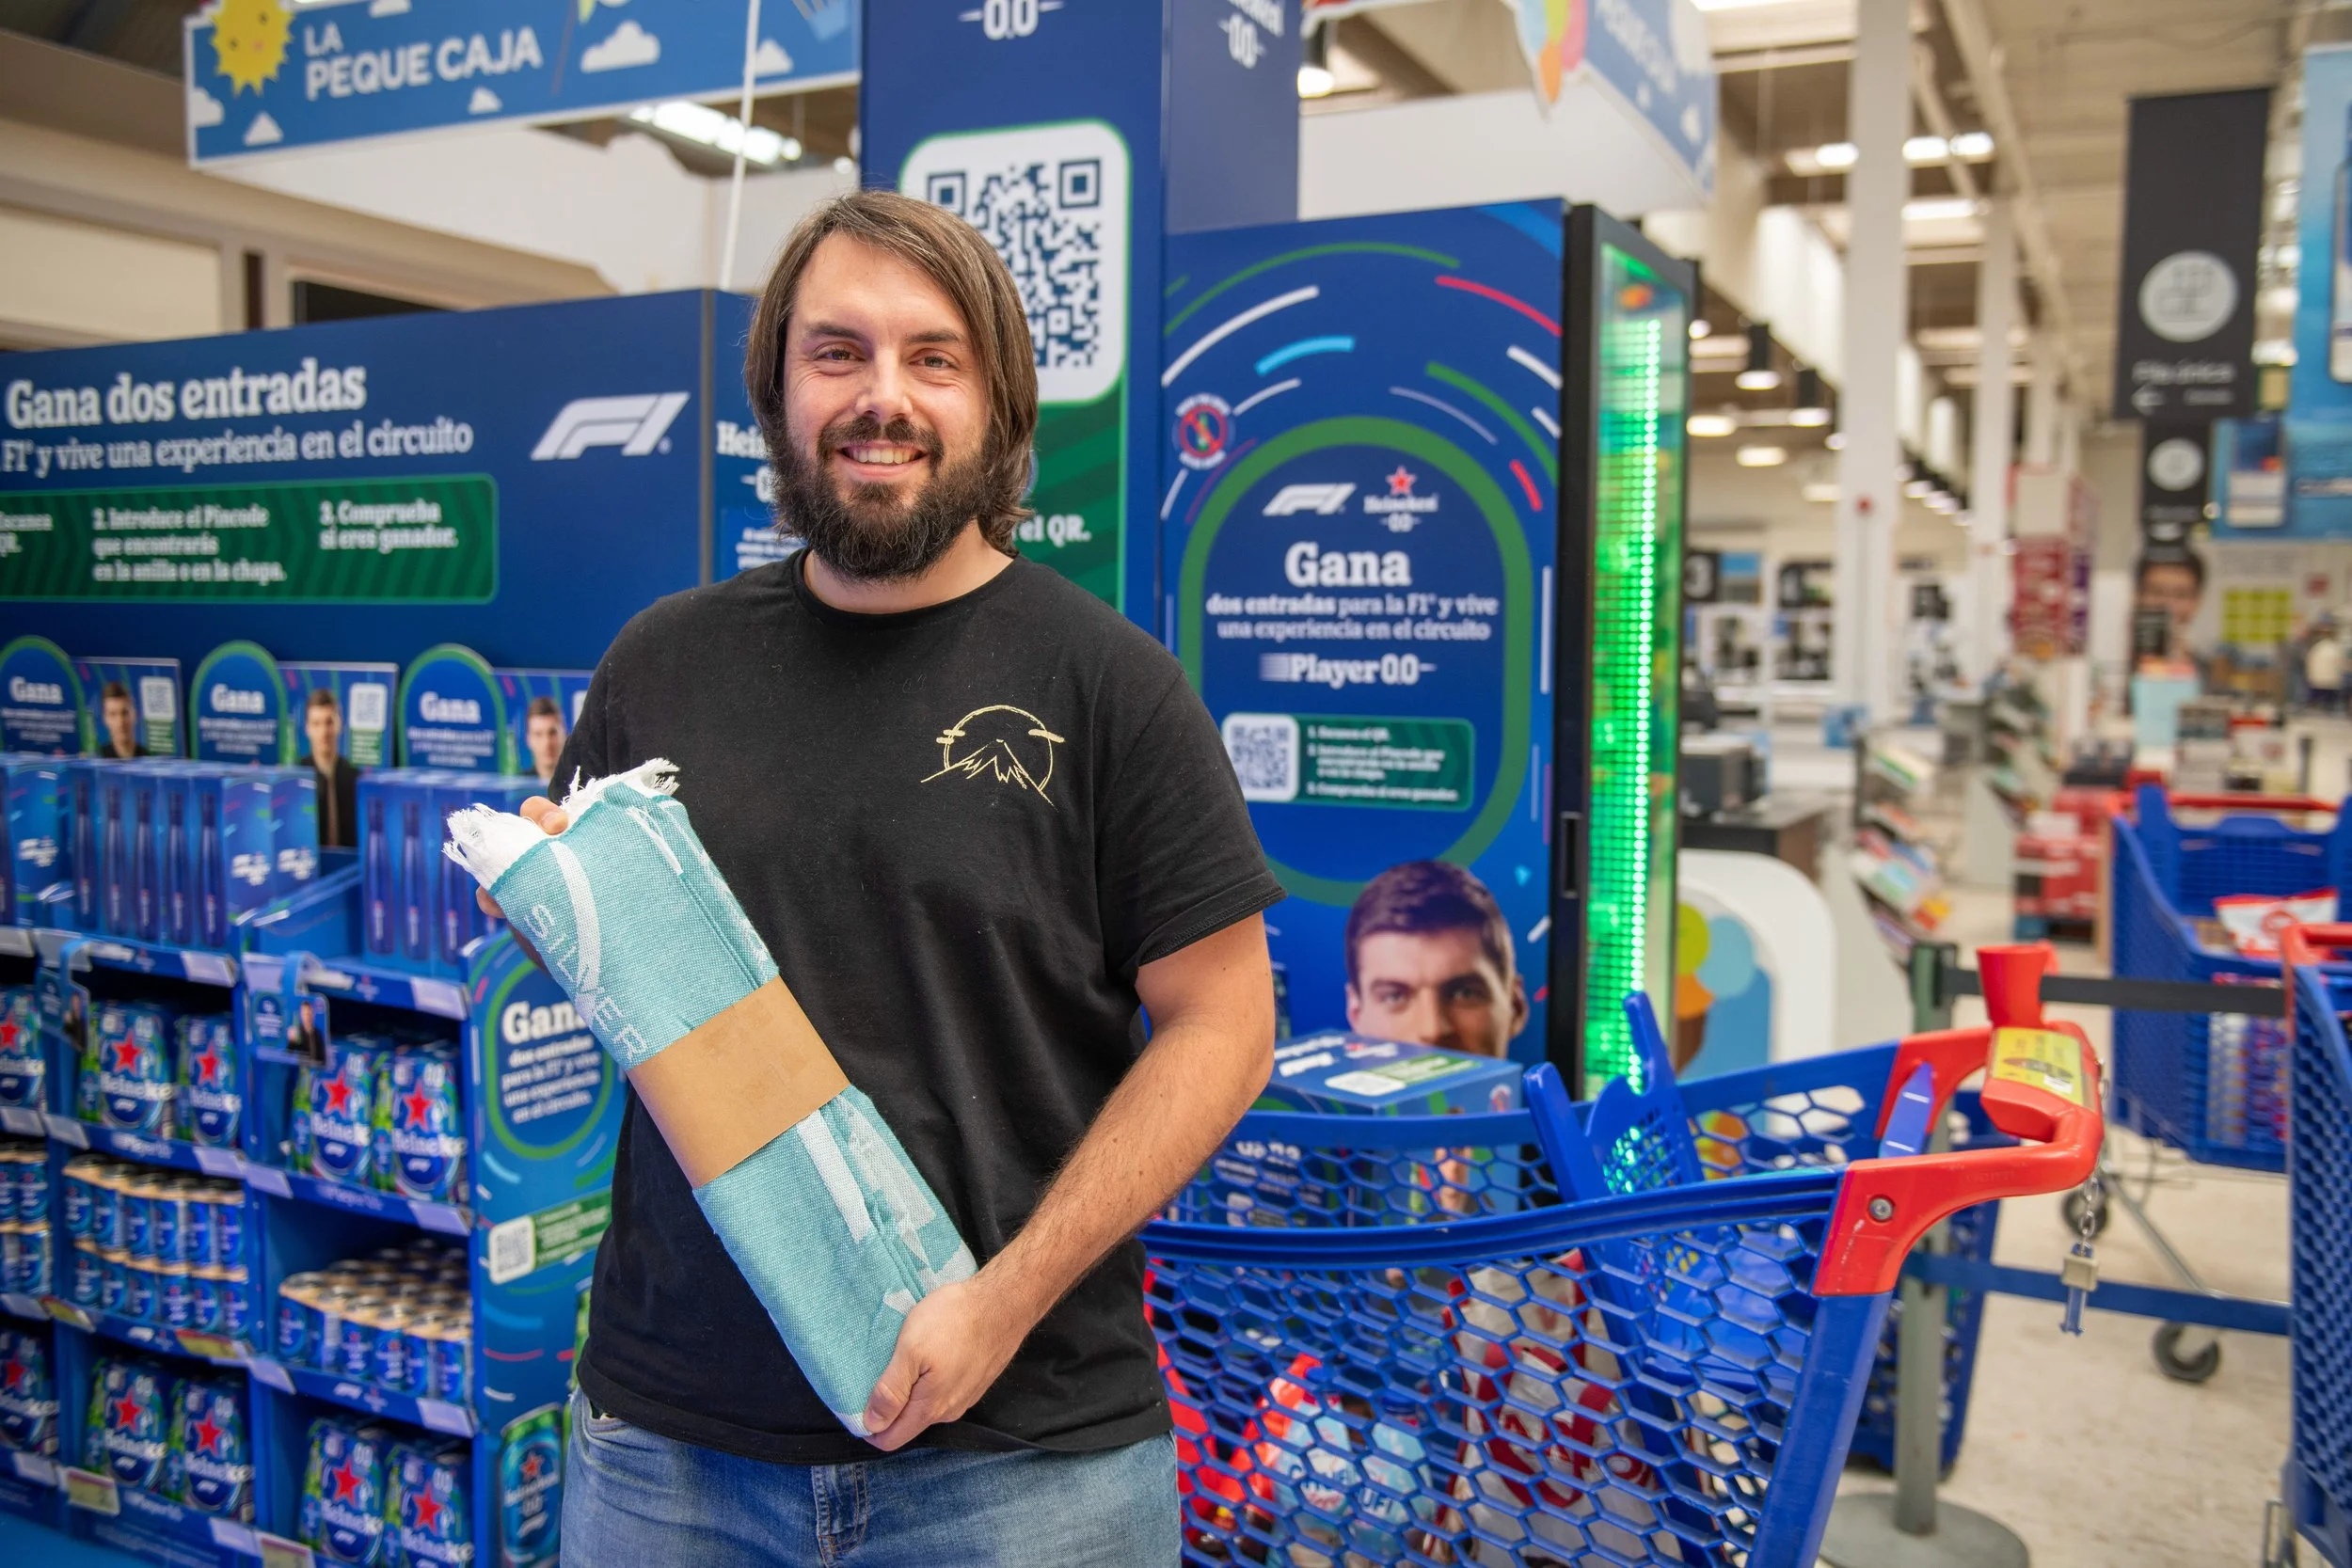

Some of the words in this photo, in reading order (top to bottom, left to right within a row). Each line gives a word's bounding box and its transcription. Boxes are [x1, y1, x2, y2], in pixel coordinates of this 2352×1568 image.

[305, 22, 343, 57] LA
[307, 43, 432, 102] PEQUE
[436, 26, 543, 82] CAJA
[7, 379, 102, 429] Gana
[107, 372, 176, 423] dos
[182, 356, 367, 420] entradas
[35, 444, 53, 478] y
[56, 436, 104, 469] vive
[107, 439, 152, 468] una
[156, 426, 299, 473] experiencia
[301, 430, 336, 460] en
[339, 420, 365, 459] el
[368, 416, 474, 457] circuito
[1019, 515, 1044, 542] el
[1046, 515, 1092, 547] QR.
[1284, 541, 1412, 587] Gana
[1206, 594, 1243, 615] dos
[1244, 593, 1335, 615] entradas
[1337, 596, 1382, 618] para
[1385, 594, 1405, 614] la
[1438, 597, 1454, 618] y
[1455, 594, 1500, 615] vive
[1217, 621, 1251, 639] una
[1254, 618, 1363, 643] experiencia
[1365, 621, 1391, 640] en
[1392, 618, 1411, 640] el
[1413, 617, 1492, 641] circuito
[9, 676, 64, 705] Gana
[210, 683, 265, 715] Gana
[420, 690, 482, 724] Gana
